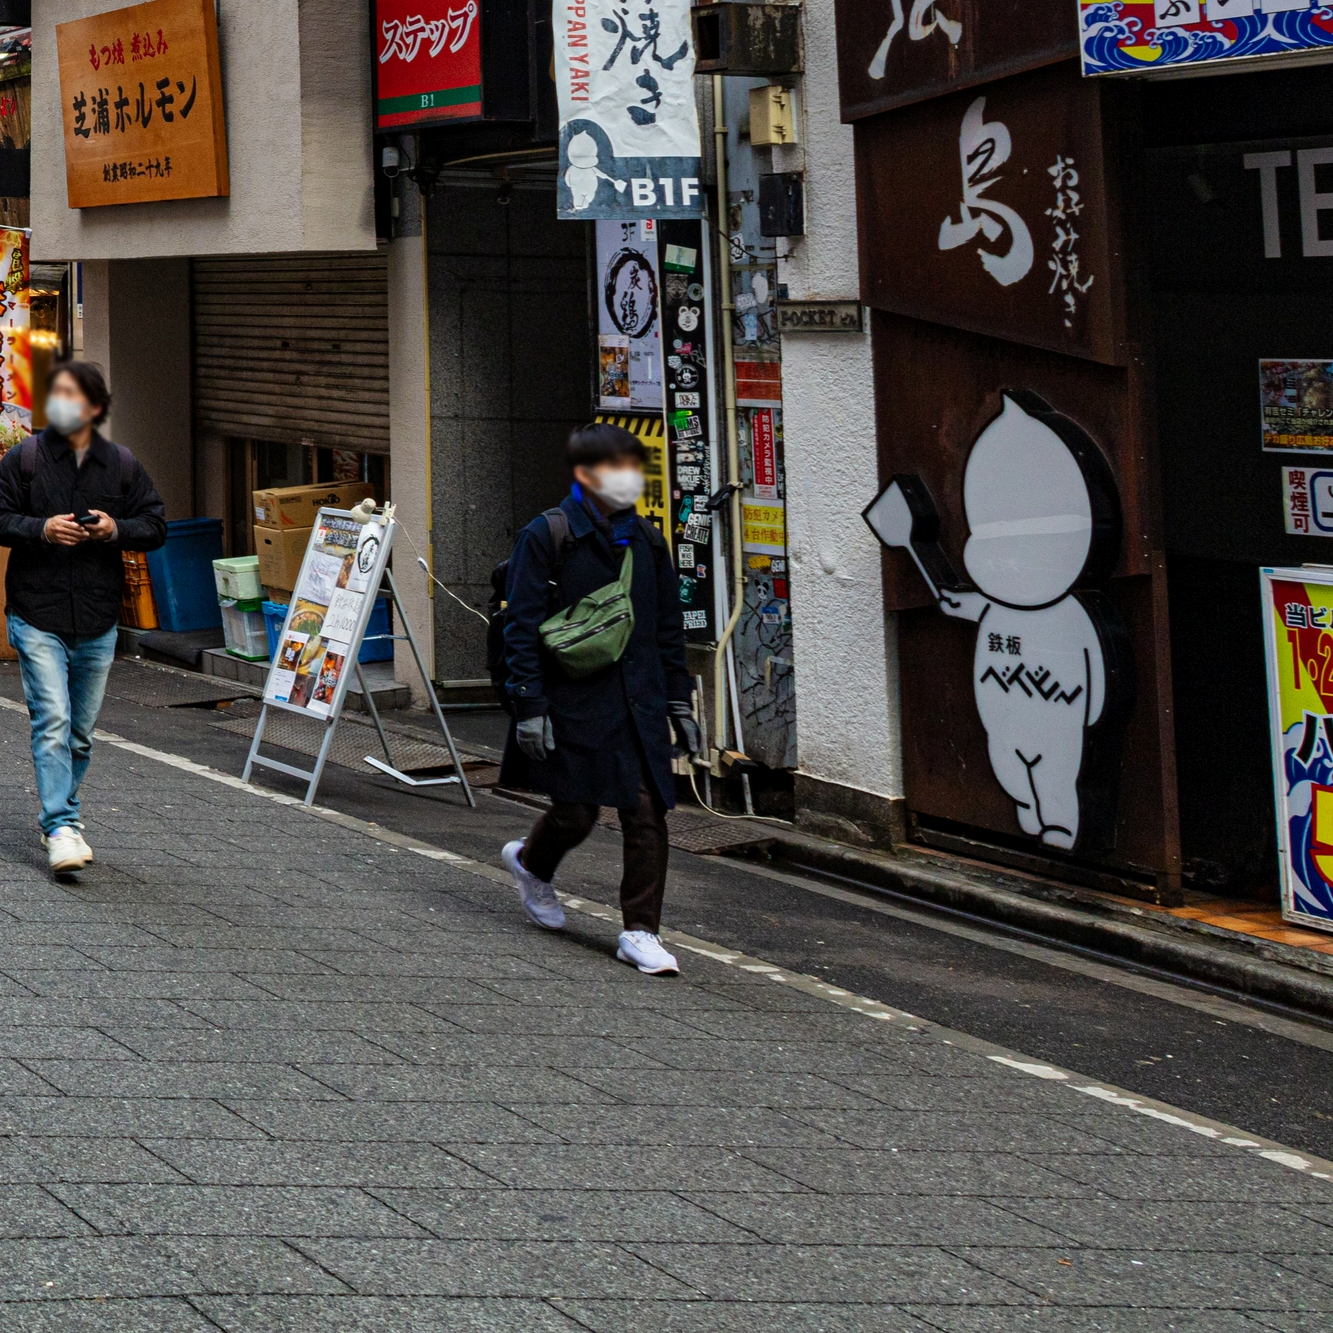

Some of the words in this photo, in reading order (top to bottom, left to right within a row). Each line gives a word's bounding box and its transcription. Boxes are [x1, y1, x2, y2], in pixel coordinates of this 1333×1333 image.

[378, 0, 479, 64] ステップ
[71, 74, 198, 139] 芝浦ホルモン
[420, 93, 436, 109] B1
[630, 177, 700, 207] B1F
[761, 412, 773, 485] 防犯カメラ監視中
[1287, 469, 1311, 533] 喫煙可
[987, 632, 1022, 657] 鉄板
